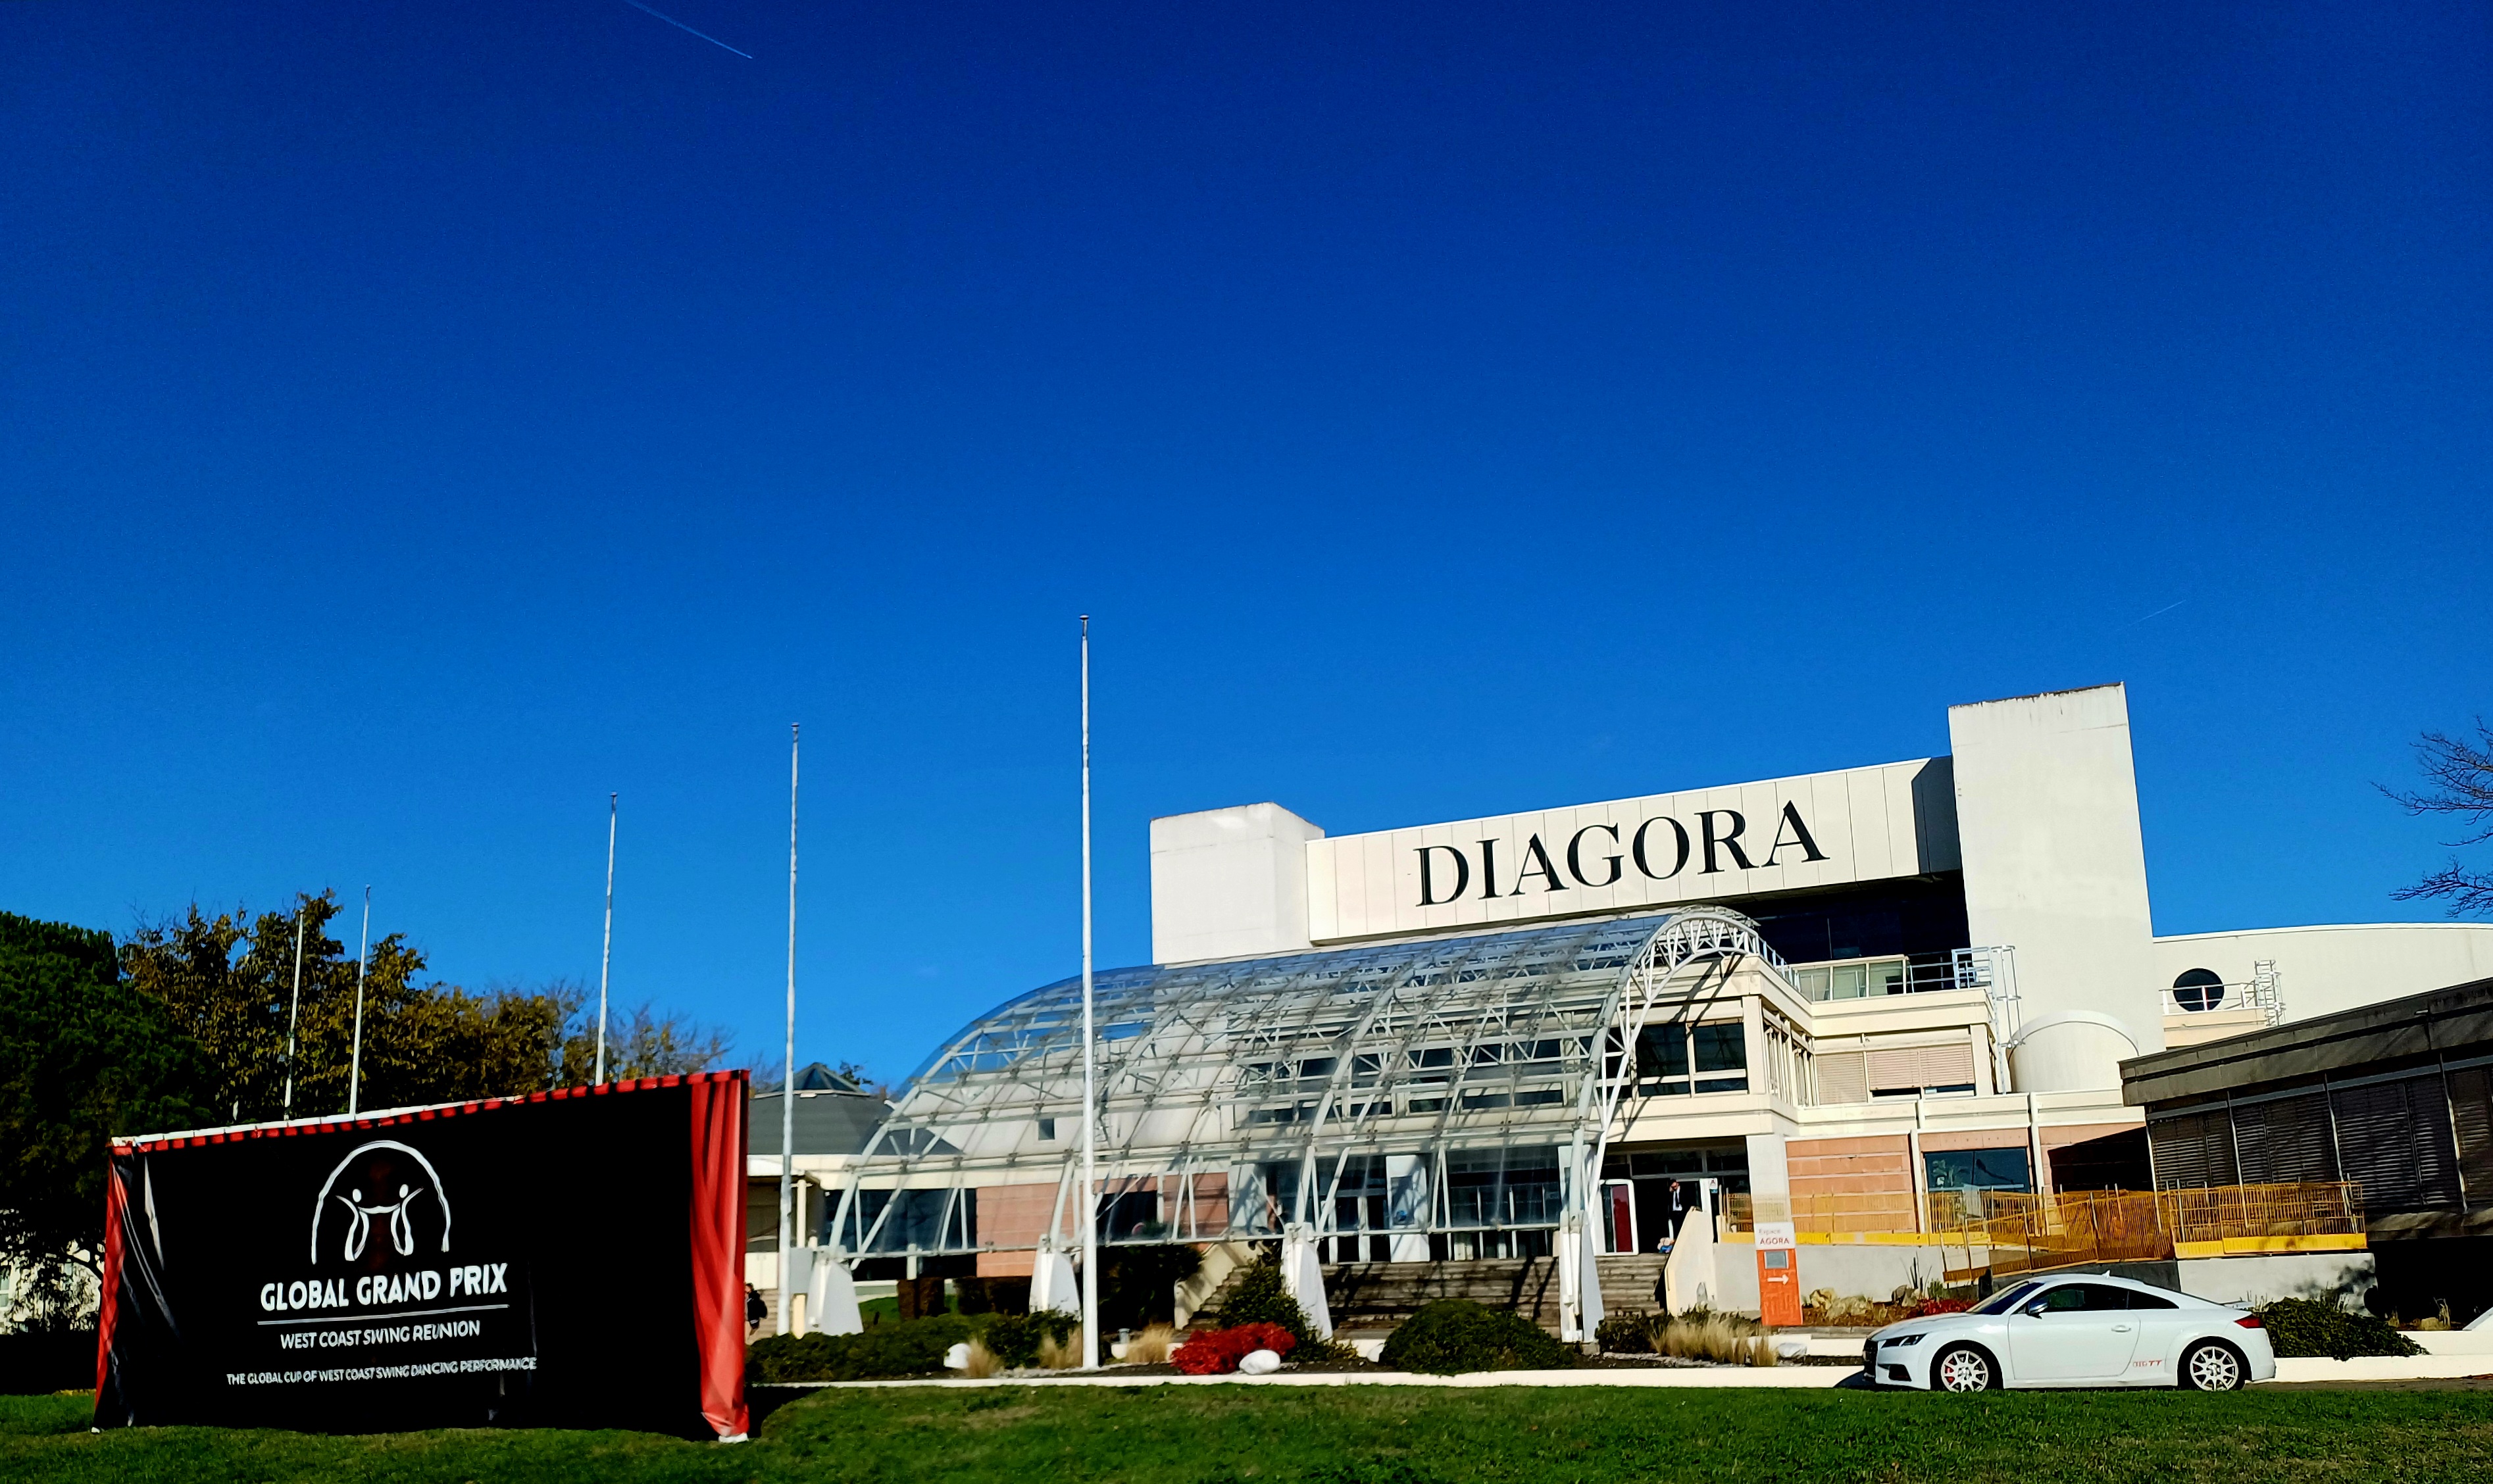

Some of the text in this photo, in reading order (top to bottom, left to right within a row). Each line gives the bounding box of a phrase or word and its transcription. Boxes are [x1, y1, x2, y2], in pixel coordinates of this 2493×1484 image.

[1413, 800, 1830, 907] DIAGORA
[261, 1263, 508, 1311] GLOBAL GRAND PRIX
[280, 1320, 480, 1349] WEST COAST SWING REUNION
[226, 1357, 537, 1385] THE GLOBAL CUP OF WEST COAST SWING DANCING PERFORMANCE
